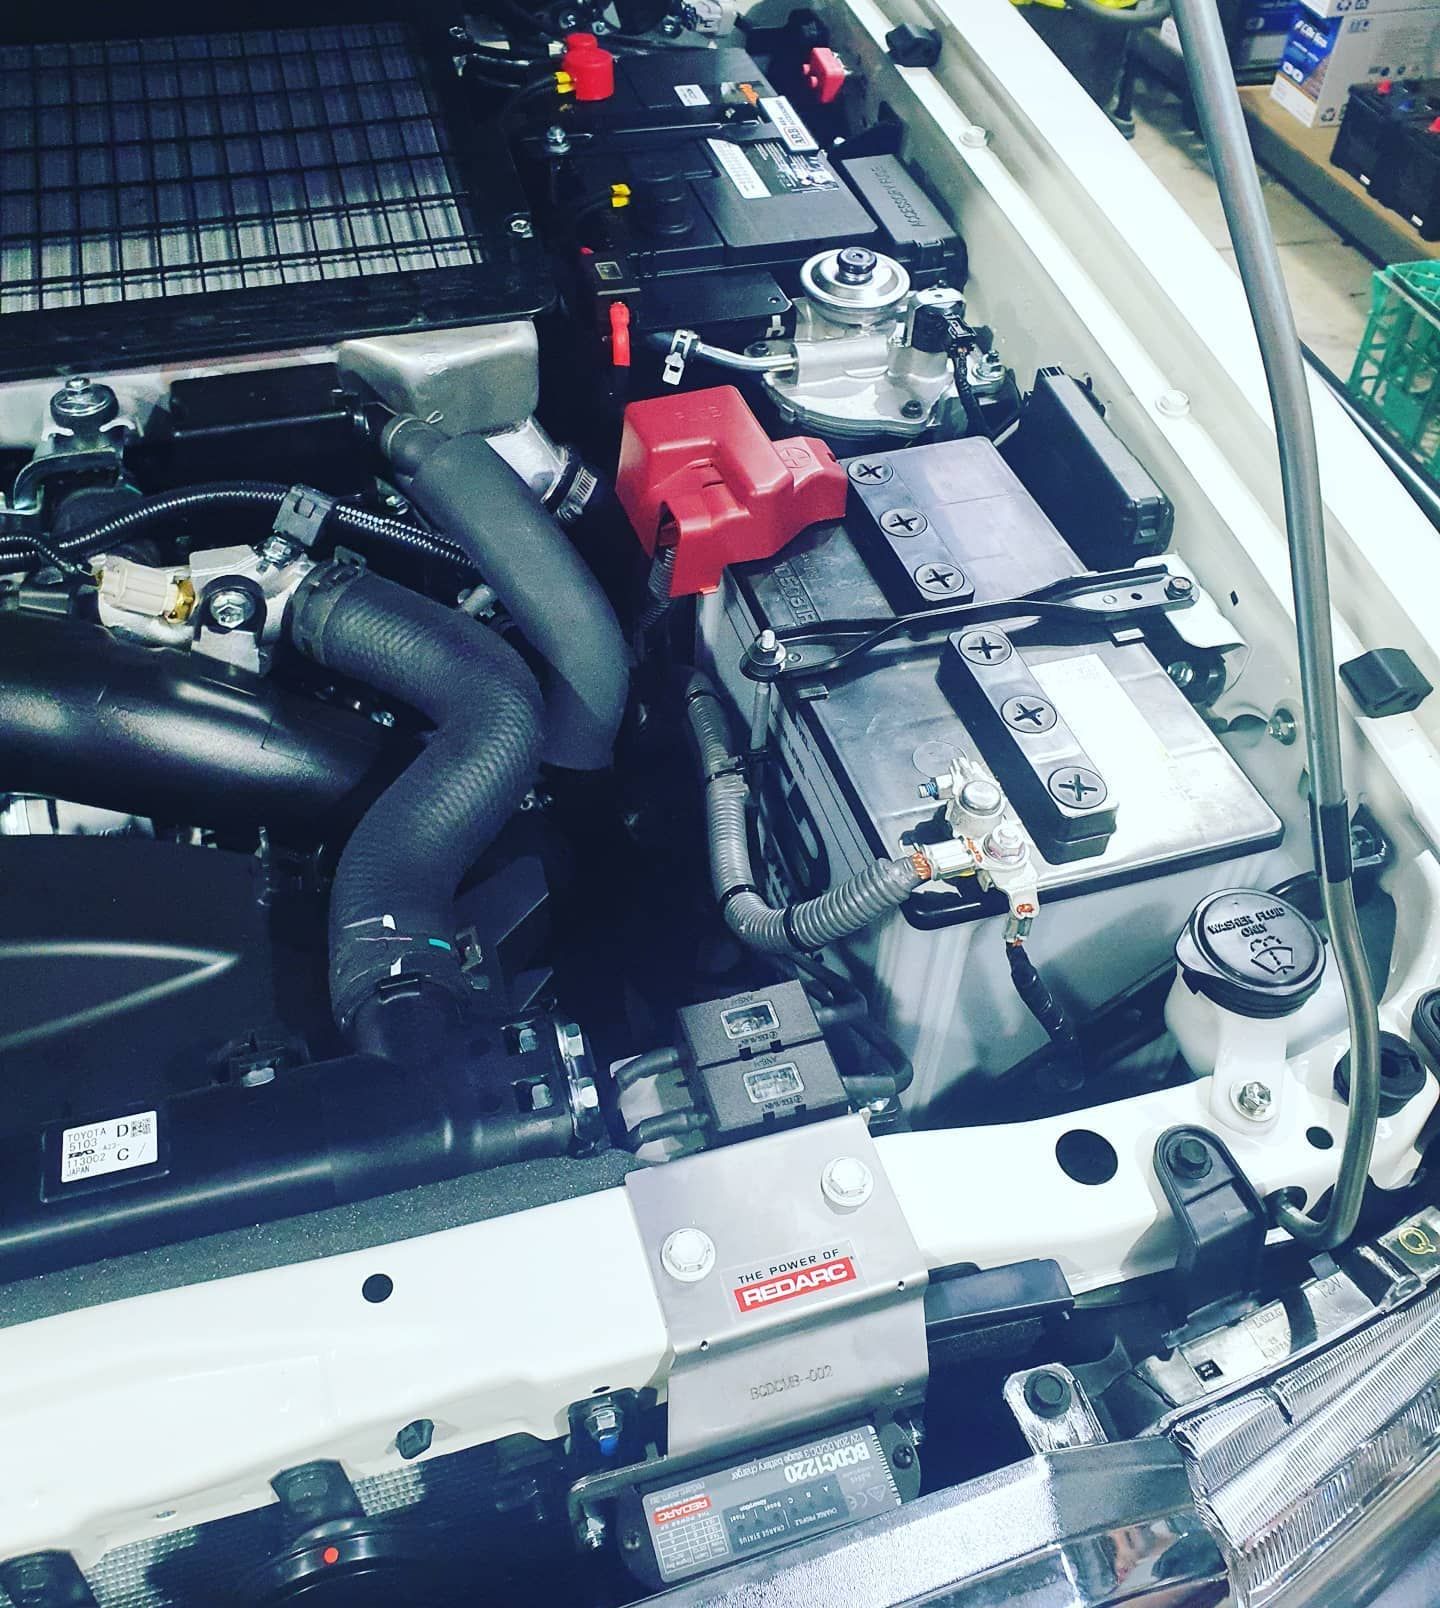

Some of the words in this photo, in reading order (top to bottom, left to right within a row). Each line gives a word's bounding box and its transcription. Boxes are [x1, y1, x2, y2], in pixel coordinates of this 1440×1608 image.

[1207, 916, 1254, 935] WASHER
[1255, 907, 1285, 922] FLUID
[1241, 924, 1268, 937] ONLY
[67, 1127, 106, 1143] TOYOTA
[117, 1122, 128, 1137] D
[69, 1137, 97, 1152] 5103
[66, 1152, 105, 1169] 113002
[117, 1146, 128, 1161] C
[66, 1164, 89, 1176] JAPAN
[738, 1271, 764, 1284] THE
[769, 1256, 817, 1276] POWER
[823, 1249, 840, 1260] OF
[742, 1263, 849, 1306] REDARC
[832, 1436, 850, 1448] 20A
[849, 1431, 863, 1443] 12V
[757, 1455, 784, 1473] battery
[782, 1440, 871, 1485] BCDC1220
[728, 1463, 759, 1482] charger
[656, 1497, 708, 1523] REDARC
[815, 1506, 837, 1518] CHARGE
[794, 1513, 817, 1526] PROFILE
[738, 1531, 760, 1544] STATUS
[760, 1523, 784, 1536] CHARGE
